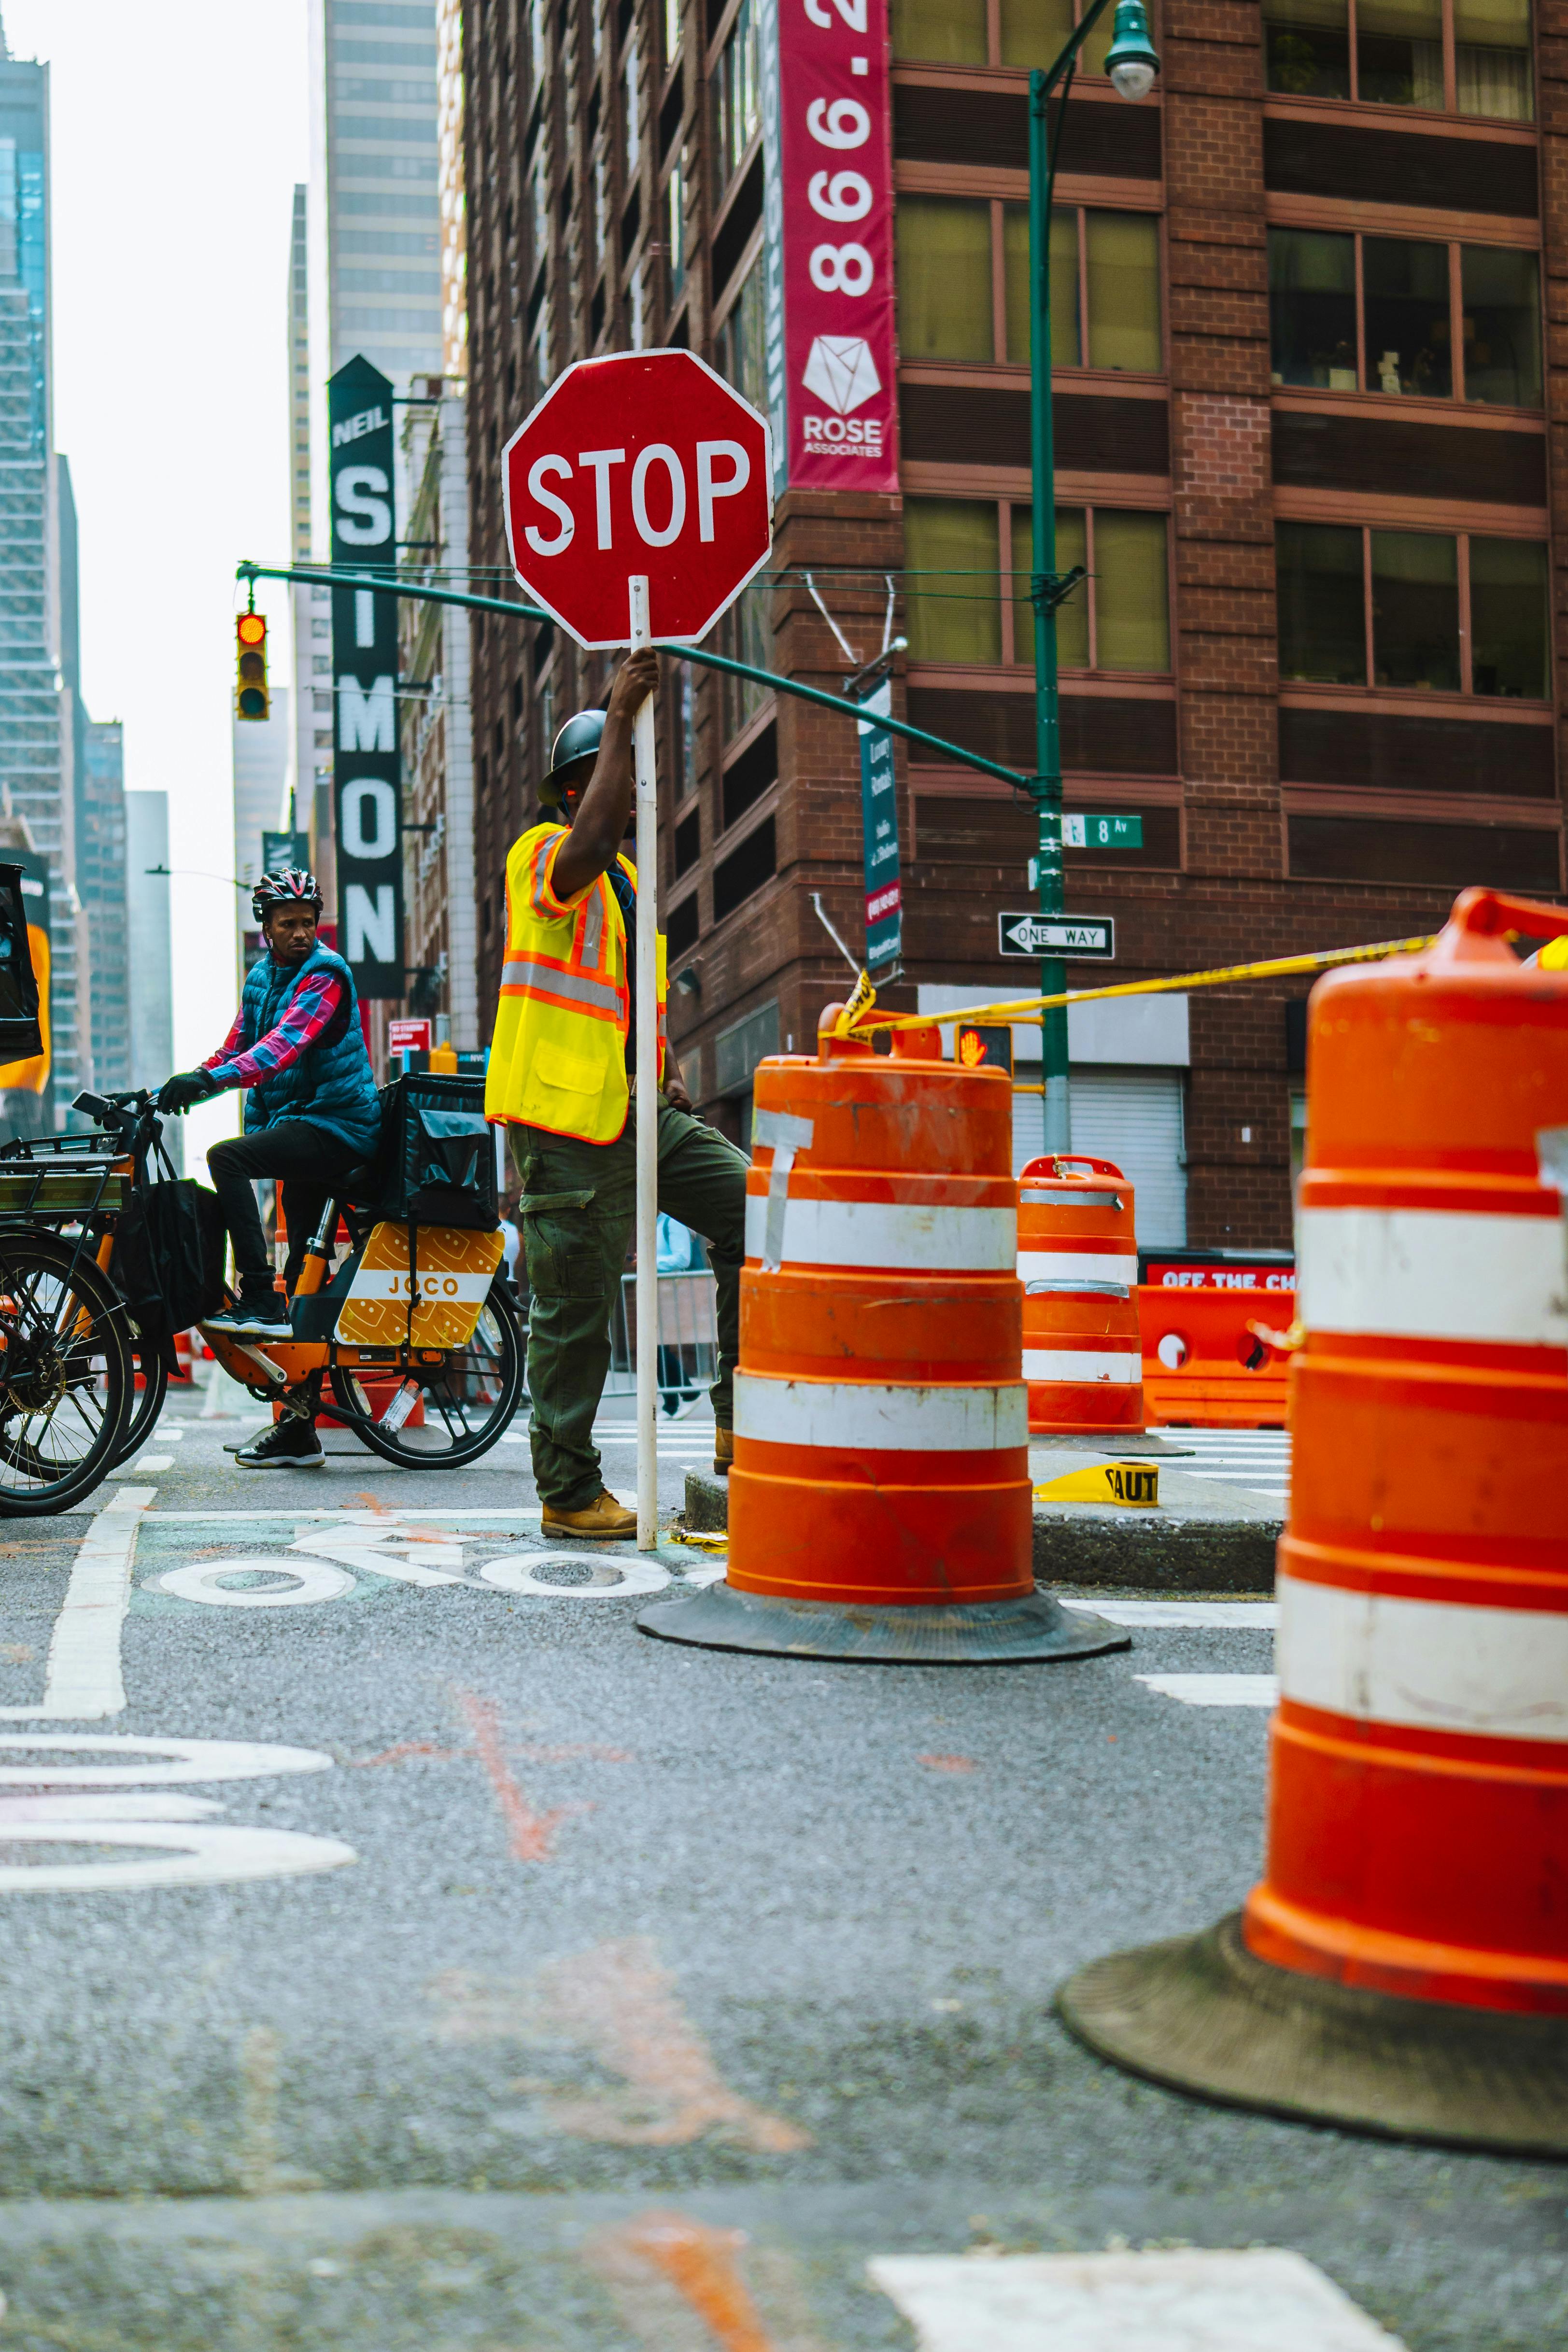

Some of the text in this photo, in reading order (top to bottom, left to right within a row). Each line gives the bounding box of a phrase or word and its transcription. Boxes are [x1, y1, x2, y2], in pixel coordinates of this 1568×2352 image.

[333, 405, 388, 448] NEIL
[804, 416, 882, 444] ROSE
[804, 442, 882, 457] ASSOCIATES
[524, 440, 750, 556] STOP
[1099, 819, 1127, 843] 8 Av
[1018, 927, 1097, 945] ONE WAY
[389, 1276, 458, 1296] JOCO
[1266, 1274, 1296, 1290] CH
[1105, 1469, 1158, 1502] CAUT
